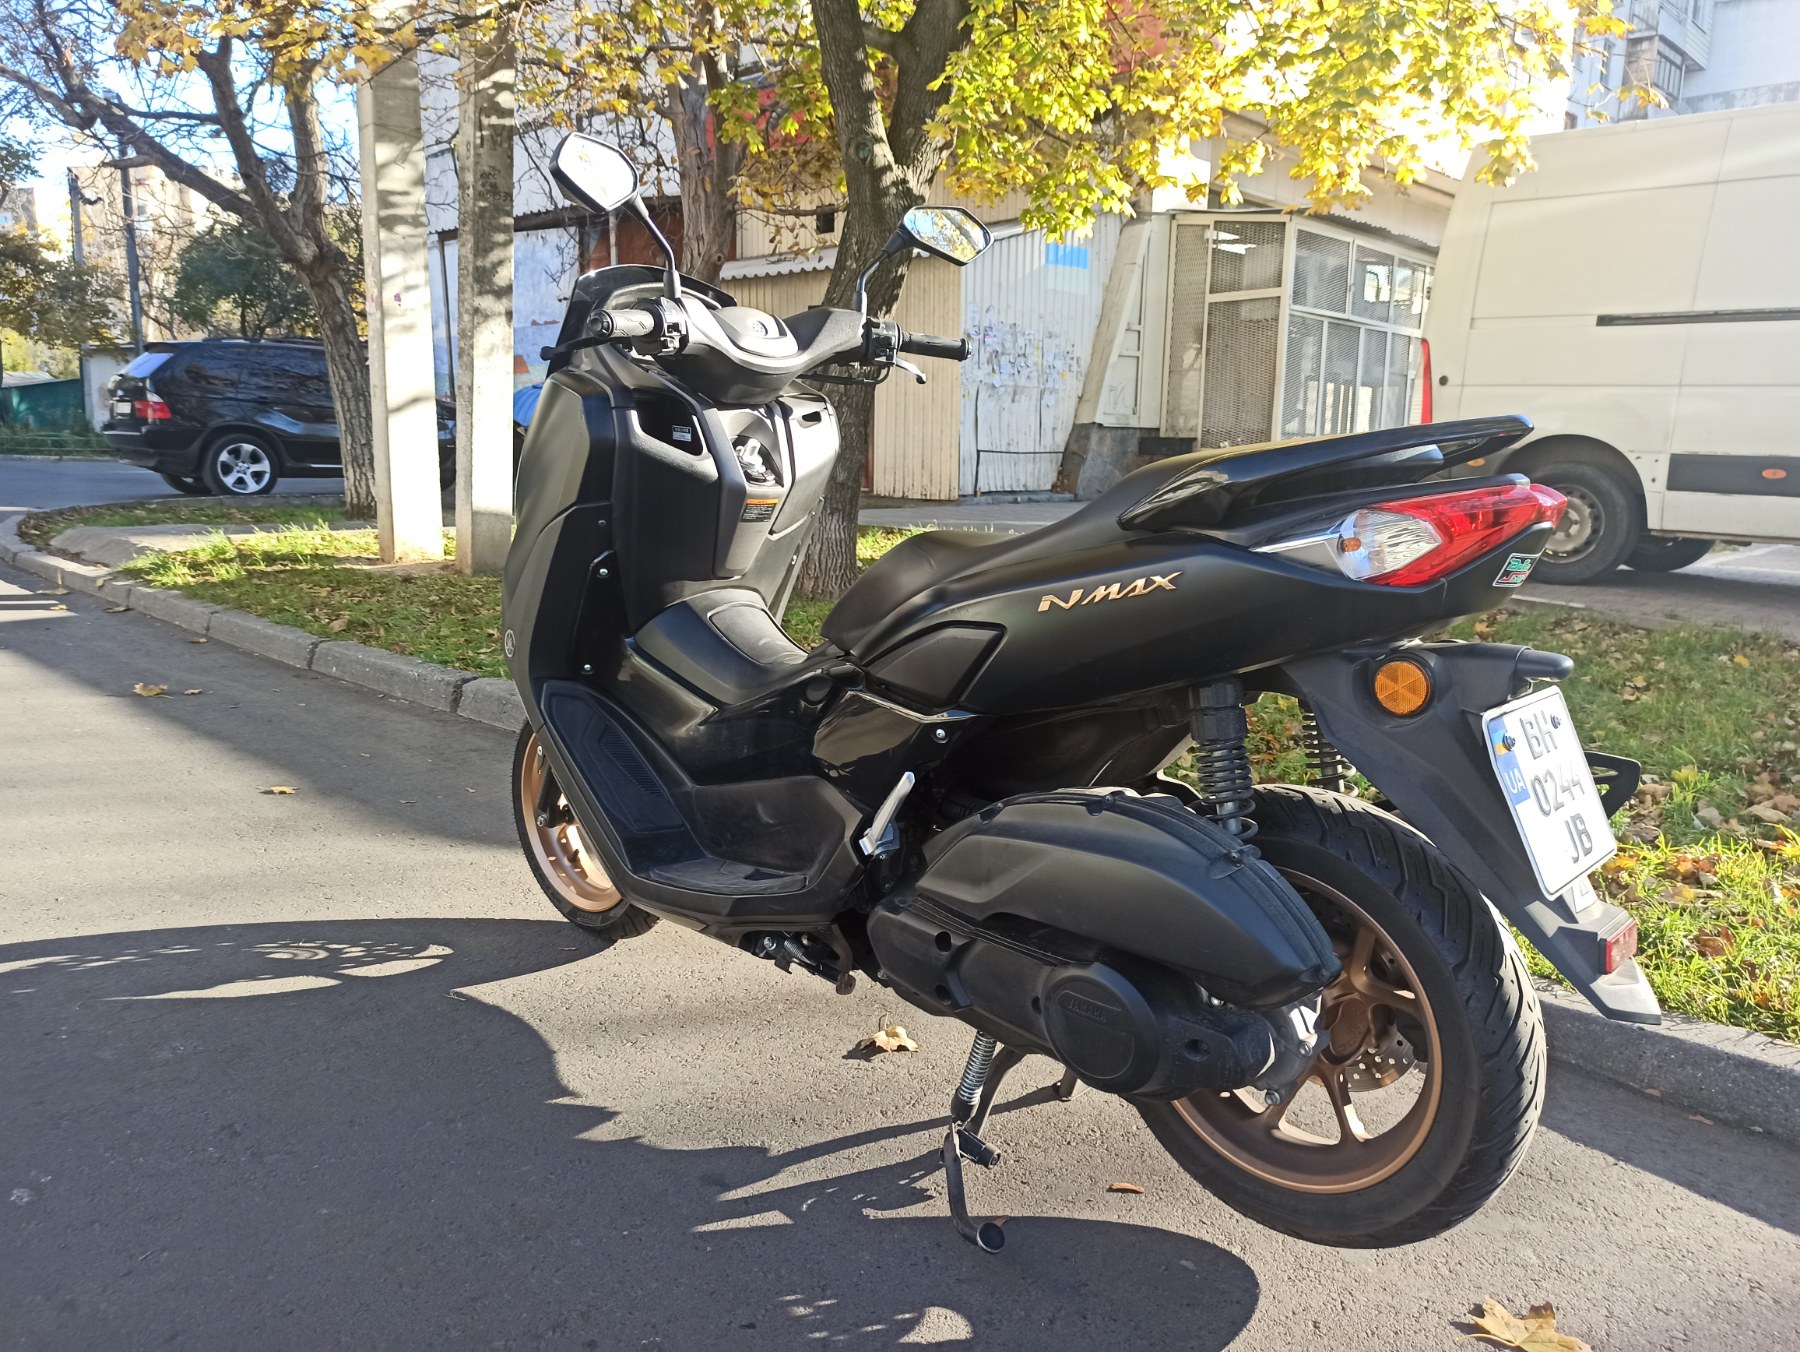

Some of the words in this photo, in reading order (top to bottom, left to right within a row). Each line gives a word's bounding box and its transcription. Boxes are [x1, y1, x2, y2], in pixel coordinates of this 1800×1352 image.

[1037, 571, 1183, 613] NMAX
[1520, 710, 1557, 760] BH
[1506, 768, 1526, 794] UA
[1529, 762, 1586, 818] 0244
[1564, 813, 1593, 863] JB
